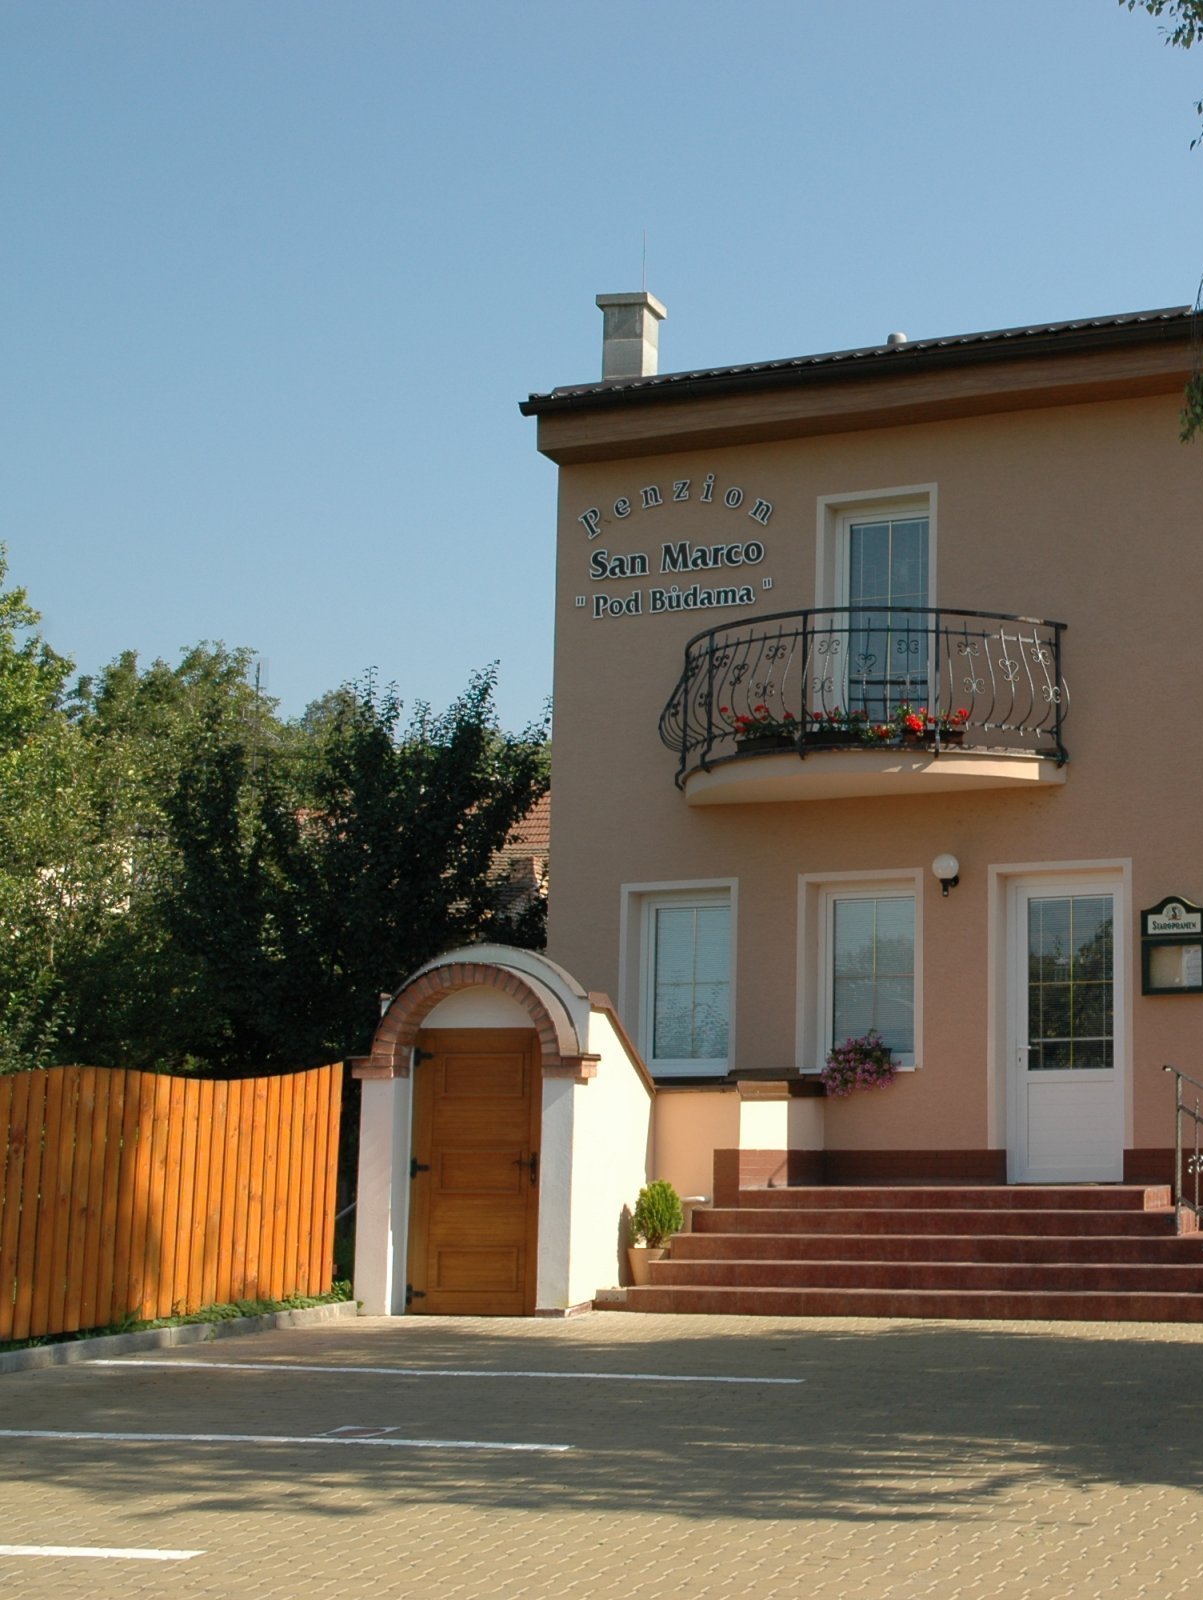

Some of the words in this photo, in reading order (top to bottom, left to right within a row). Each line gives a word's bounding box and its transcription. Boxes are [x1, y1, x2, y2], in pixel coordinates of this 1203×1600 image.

[578, 473, 773, 540] Penzion
[590, 549, 649, 580] San
[660, 540, 765, 574] Marco
[593, 590, 642, 618] Pod
[1152, 920, 1197, 931] STAROPRAMEN
